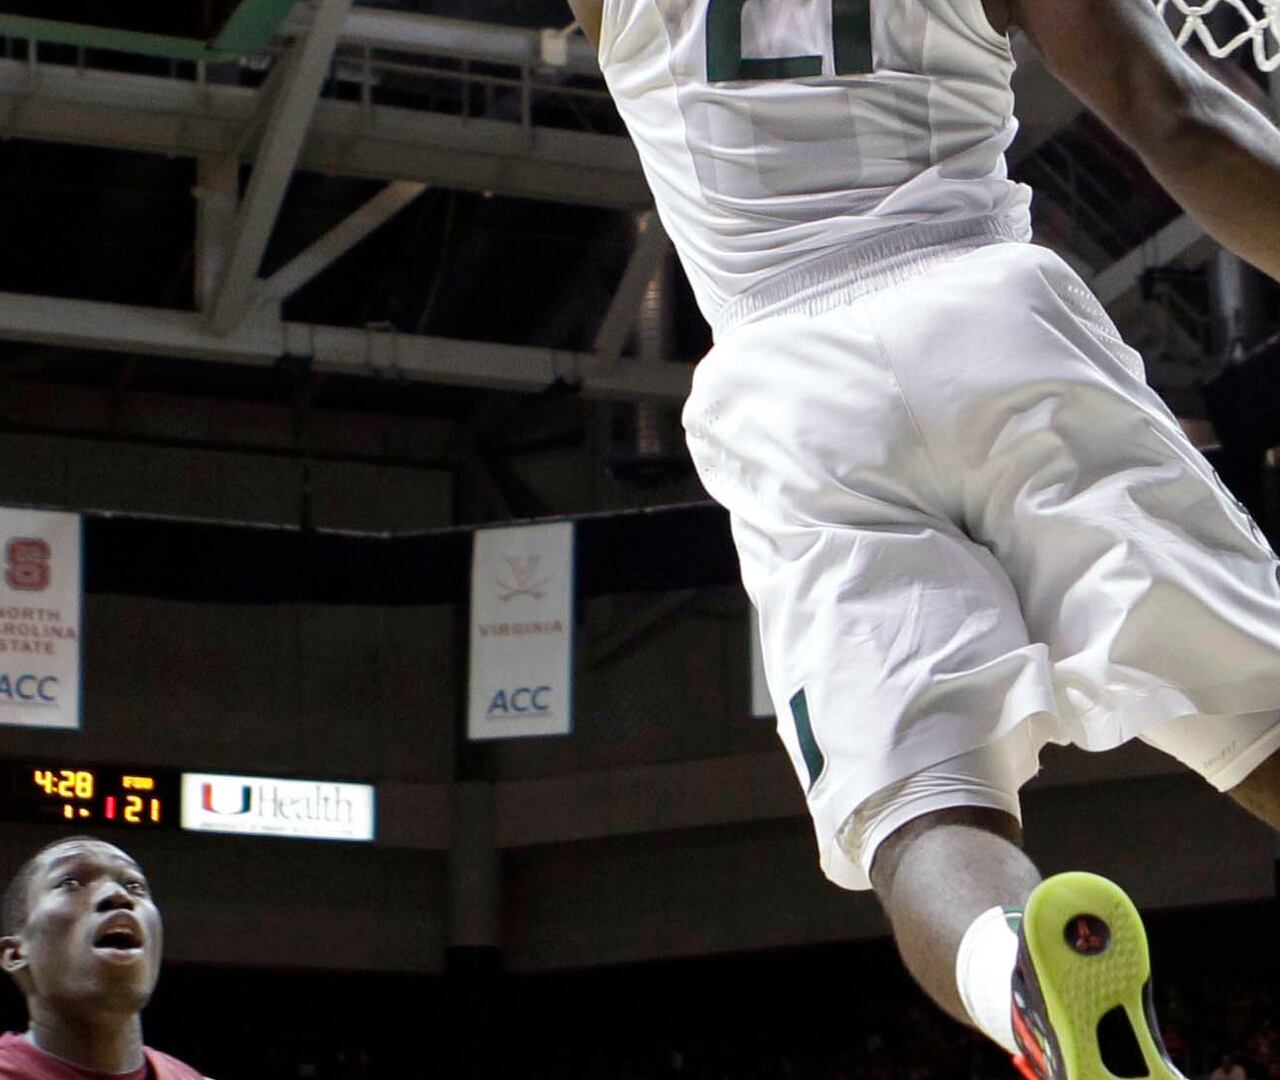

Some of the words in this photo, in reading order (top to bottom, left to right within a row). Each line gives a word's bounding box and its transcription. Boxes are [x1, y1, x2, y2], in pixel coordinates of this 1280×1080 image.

[479, 620, 562, 637] VIRGINIA
[487, 685, 552, 714] ACC
[34, 770, 94, 799] 4:28
[124, 795, 159, 822] 21
